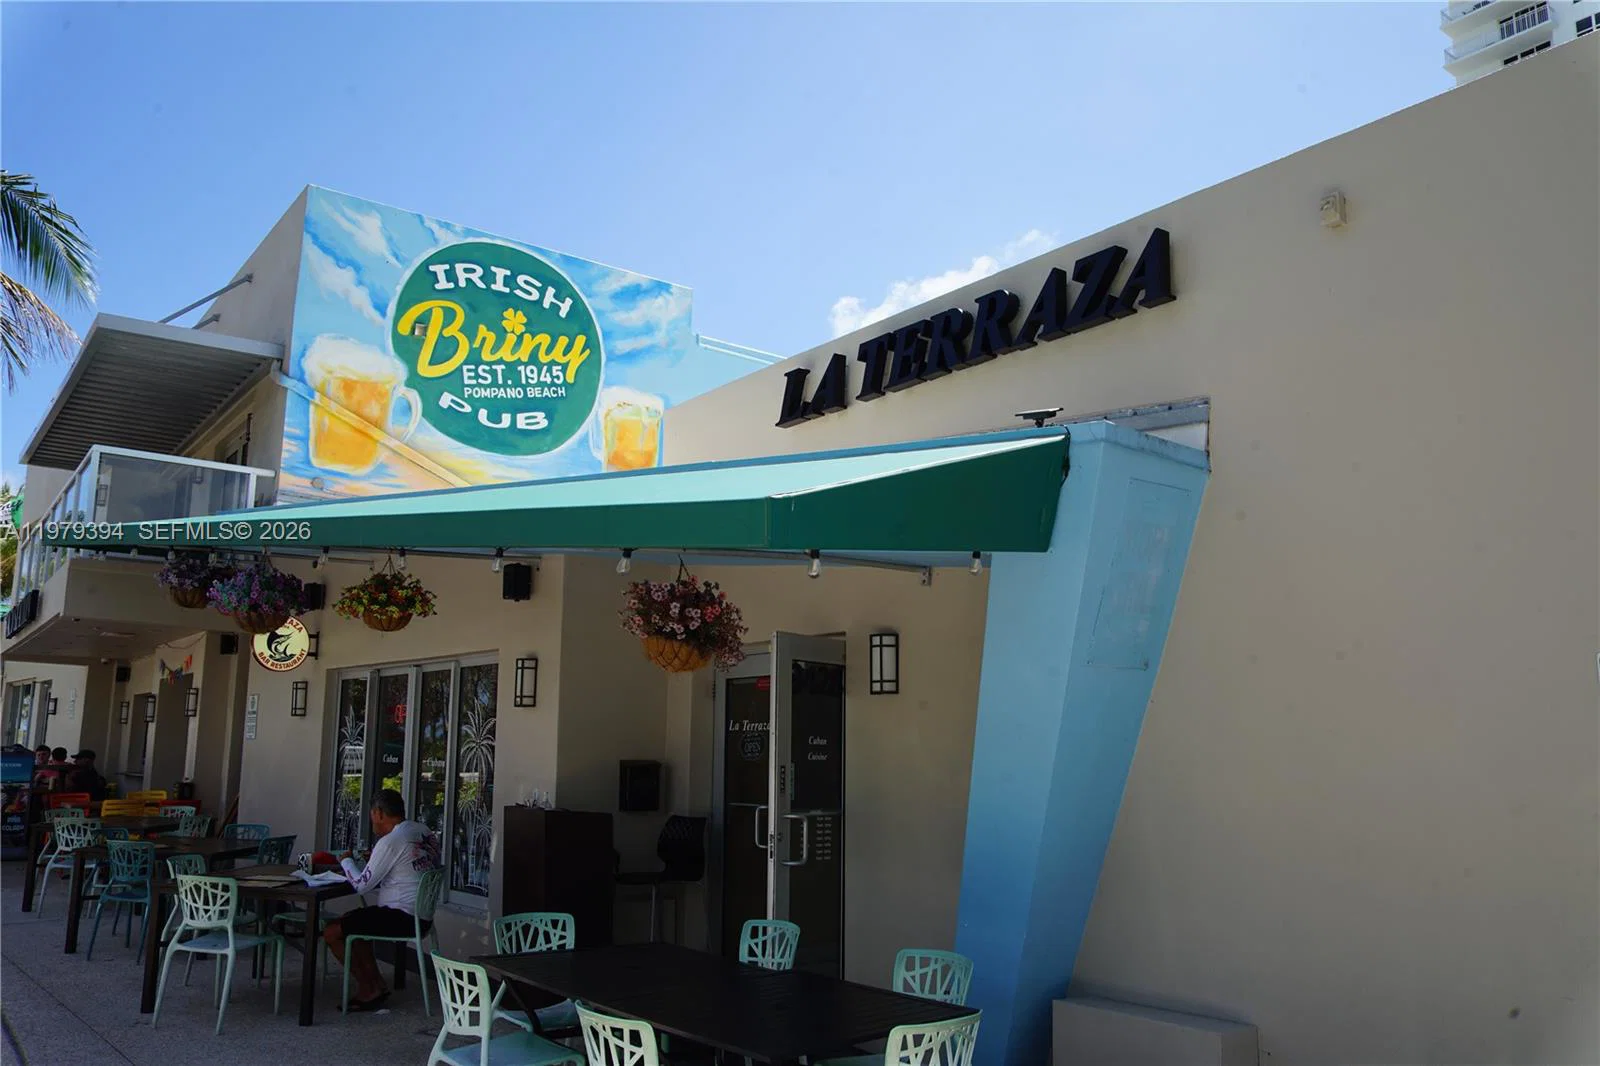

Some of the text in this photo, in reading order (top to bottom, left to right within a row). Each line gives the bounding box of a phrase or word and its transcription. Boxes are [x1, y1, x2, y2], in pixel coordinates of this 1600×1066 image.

[428, 262, 574, 319] IRISH
[397, 300, 591, 384] Briny
[775, 228, 1177, 428] LA TERRAZA
[463, 364, 565, 386] EST. 1945
[464, 386, 566, 399] POMPANO BEACH
[438, 391, 549, 430] PUB
[258, 648, 306, 669] BAR RESTAURANT
[729, 720, 739, 731] La
